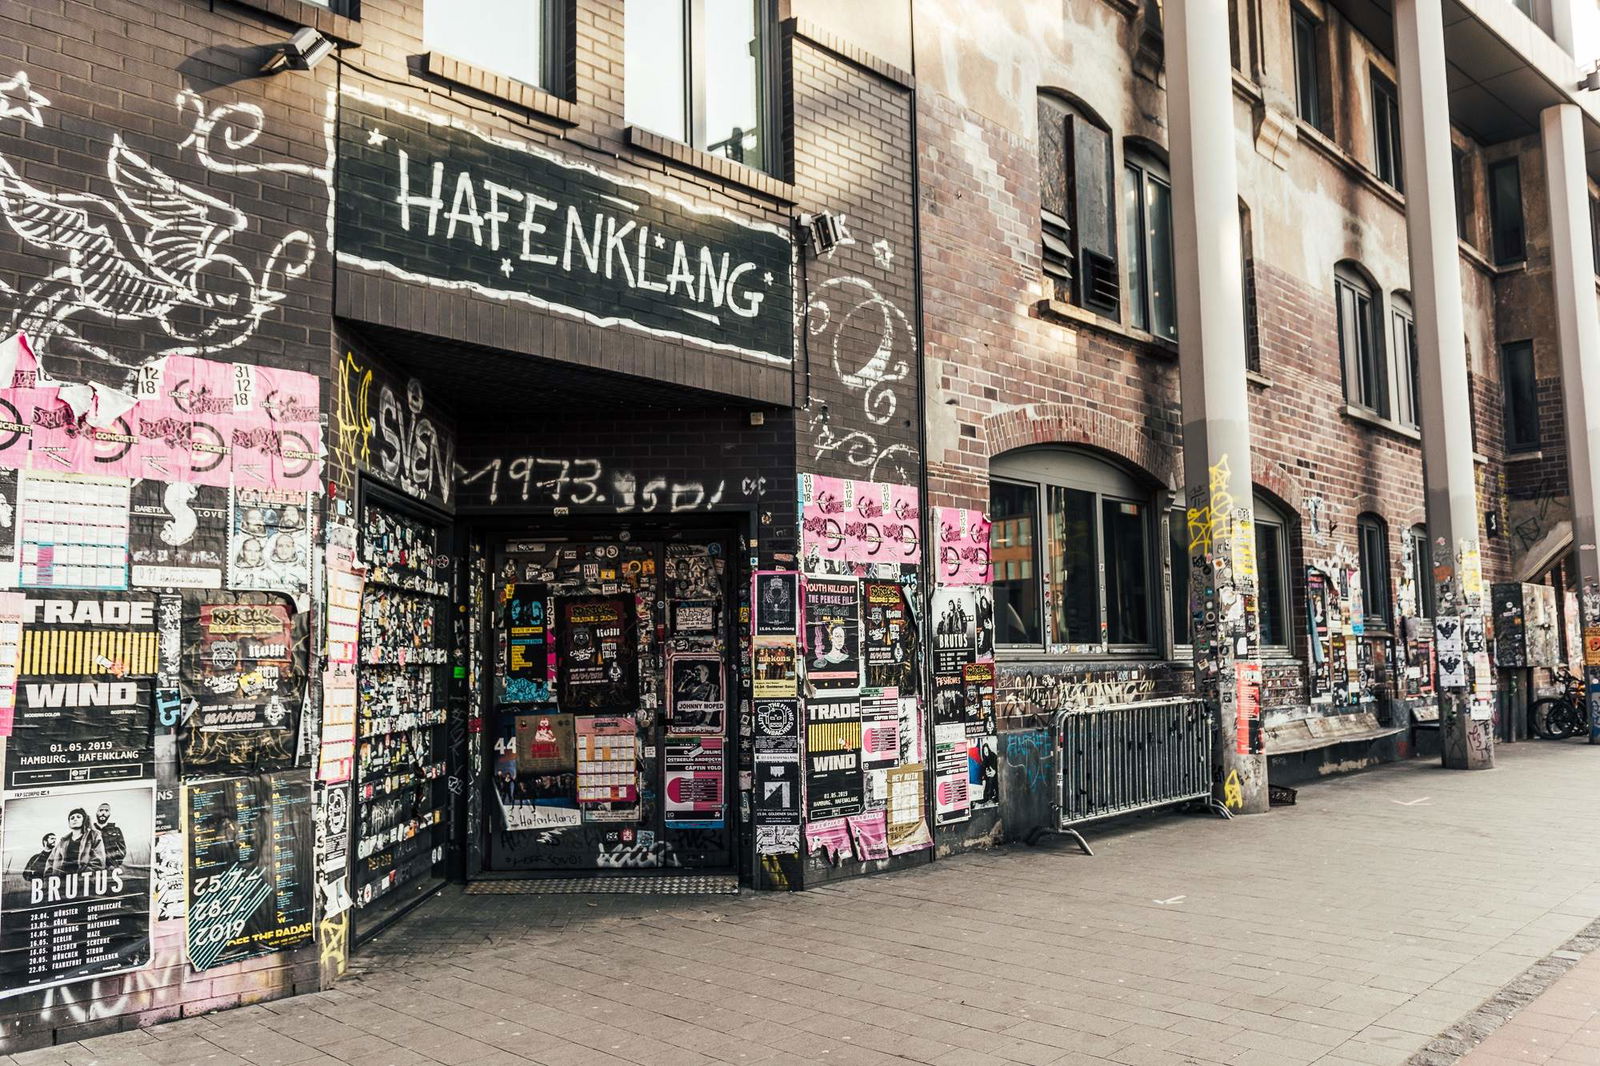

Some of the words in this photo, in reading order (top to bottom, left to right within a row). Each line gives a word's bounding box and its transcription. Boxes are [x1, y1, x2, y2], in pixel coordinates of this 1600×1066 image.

[396, 149, 764, 318] HAFENKLANG
[144, 366, 160, 380] 12
[235, 365, 250, 378] 31
[140, 380, 156, 394] 18
[237, 378, 251, 392] 12
[234, 392, 249, 406] 18
[95, 432, 140, 444] CONCRETE
[198, 510, 224, 518] LOVE
[805, 583, 827, 593] YOUTH
[828, 584, 848, 594] KILLED
[849, 585, 856, 594] IT
[808, 594, 819, 604] THE
[24, 599, 154, 625] TRADE
[939, 633, 968, 649] BRUTUS
[25, 682, 138, 708] WIND
[704, 702, 725, 710] MOPED
[807, 702, 860, 721] TRADE
[49, 741, 113, 752] 01.05.2019
[494, 736, 517, 755] 44
[78, 751, 139, 762] HAFENKLANG
[813, 753, 857, 773] WIND
[31, 868, 124, 905] BRUTUS
[195, 919, 246, 946] 2019
[275, 922, 312, 938] RADAR
